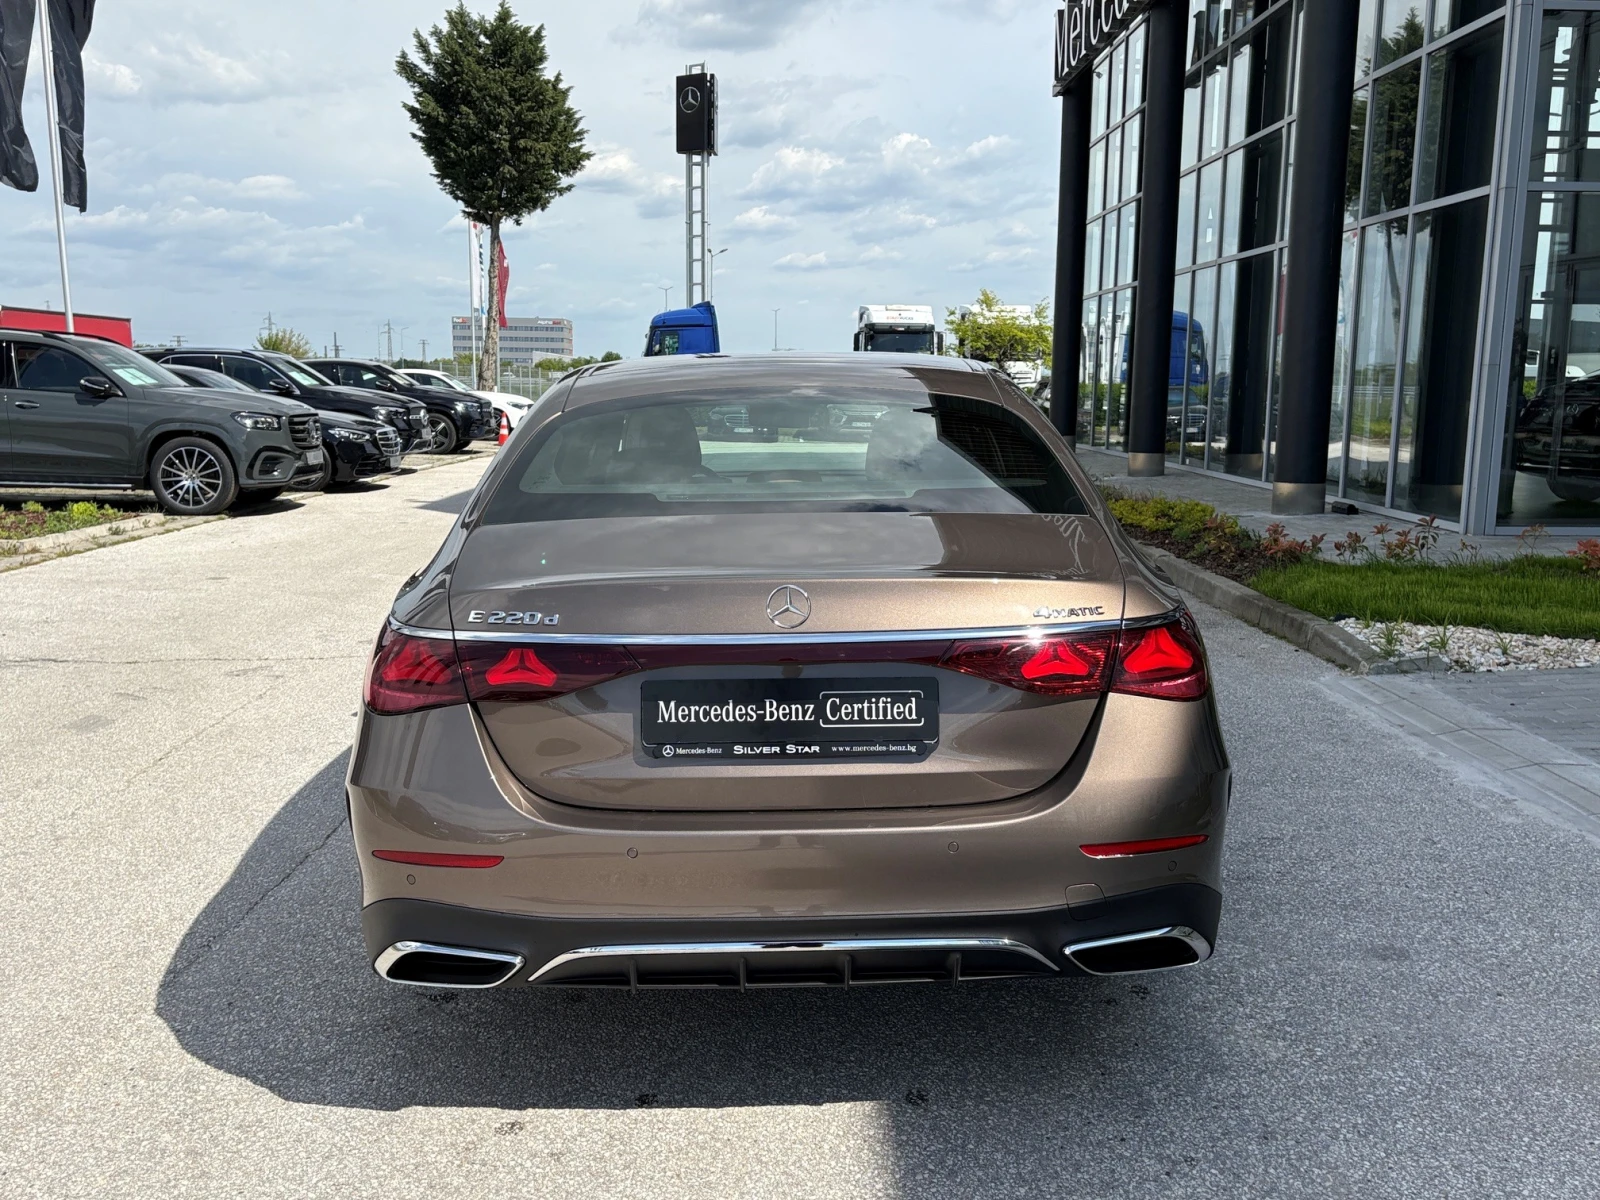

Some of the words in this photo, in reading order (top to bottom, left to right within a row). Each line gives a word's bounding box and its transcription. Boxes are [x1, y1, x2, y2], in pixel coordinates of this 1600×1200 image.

[1055, 0, 1129, 78] Merc
[467, 610, 486, 624] E
[1033, 606, 1105, 619] 4MATIC
[657, 699, 815, 724] Mercedes-Benz
[826, 697, 918, 722] Certified
[733, 745, 781, 755] SILVER
[786, 744, 820, 754] STAR
[831, 743, 917, 753] www.mercedes-benz.bg
